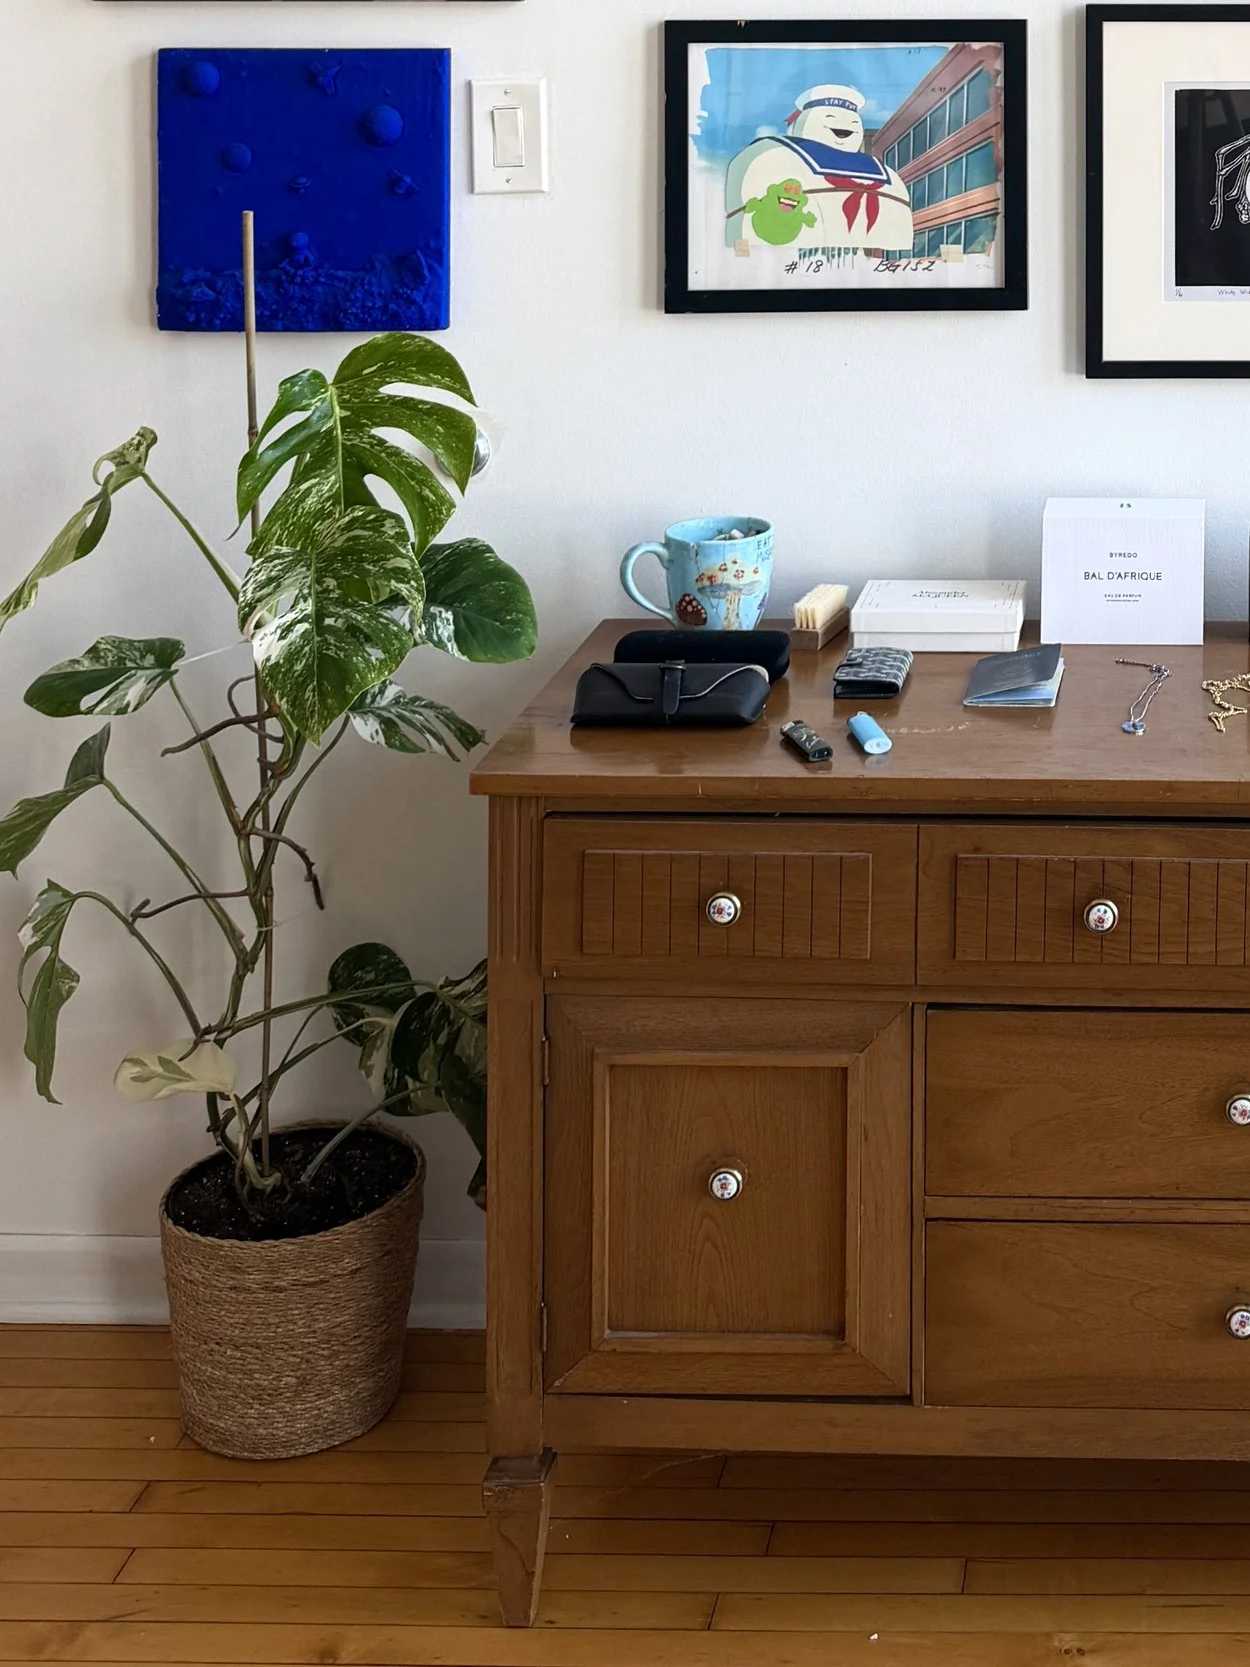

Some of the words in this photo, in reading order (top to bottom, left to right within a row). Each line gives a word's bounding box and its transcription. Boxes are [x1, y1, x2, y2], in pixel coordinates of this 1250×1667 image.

[805, 259, 824, 274] 18
[1083, 571, 1104, 581] BAL
[1107, 571, 1163, 581] D'AFRIQUE
